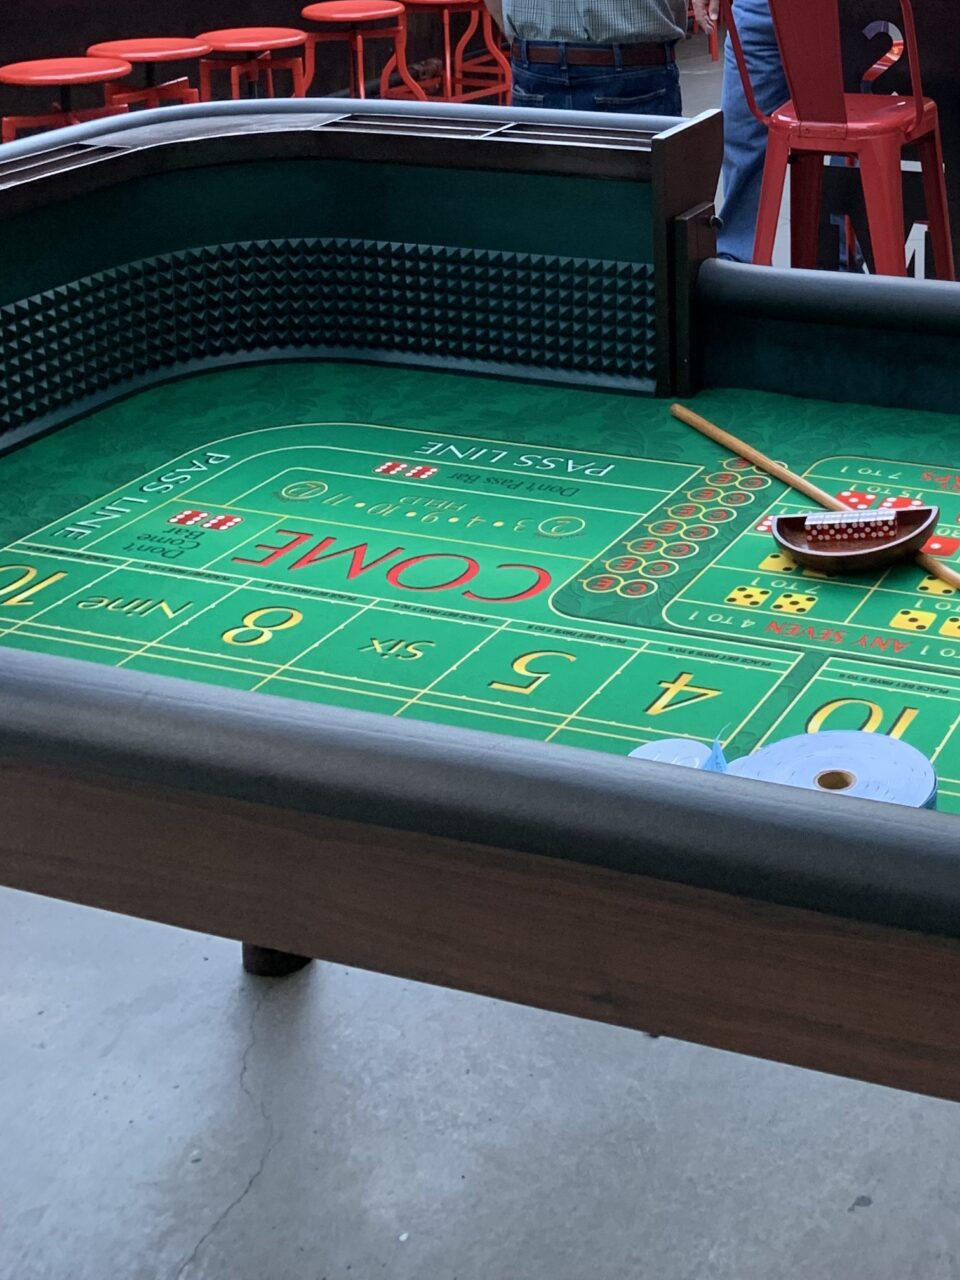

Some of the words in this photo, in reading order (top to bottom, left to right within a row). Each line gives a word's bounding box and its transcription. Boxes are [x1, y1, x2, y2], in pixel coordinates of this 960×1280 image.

[414, 441, 508, 463] LINE
[140, 452, 231, 493] PASS
[513, 455, 615, 477] PASS
[857, 466, 884, 478] TO
[447, 472, 480, 485] Bar
[716, 473, 733, 484] E
[888, 472, 902, 480] 7
[486, 477, 524, 490] Pass
[529, 482, 581, 497] Don't
[745, 478, 762, 488] C
[696, 489, 715, 500] E
[865, 484, 893, 497] TO
[727, 493, 746, 503] C
[678, 505, 696, 517] E
[708, 509, 727, 521] C
[50, 496, 148, 540] LINE
[421, 512, 440, 524] 9
[466, 514, 486, 528] 4
[513, 519, 529, 532] 3
[658, 523, 677, 534] E
[163, 527, 205, 541] Bar
[689, 527, 708, 538] C
[137, 533, 201, 550] Come
[637, 541, 656, 552] E
[122, 541, 185, 560] Don't
[669, 544, 689, 556] C
[231, 529, 553, 604] COME
[614, 557, 638, 570] E
[649, 562, 669, 575] C
[591, 576, 615, 590] E
[626, 581, 649, 595] C
[771, 580, 799, 592] TO
[804, 584, 820, 594] 7
[76, 595, 193, 619] Nine
[707, 613, 736, 626] TO
[738, 618, 756, 629] 4
[220, 606, 303, 647] 8
[764, 620, 848, 644] SEVEN
[357, 638, 437, 661] Six
[851, 634, 912, 653] ANY
[487, 649, 578, 696] 5
[642, 672, 723, 717] 4
